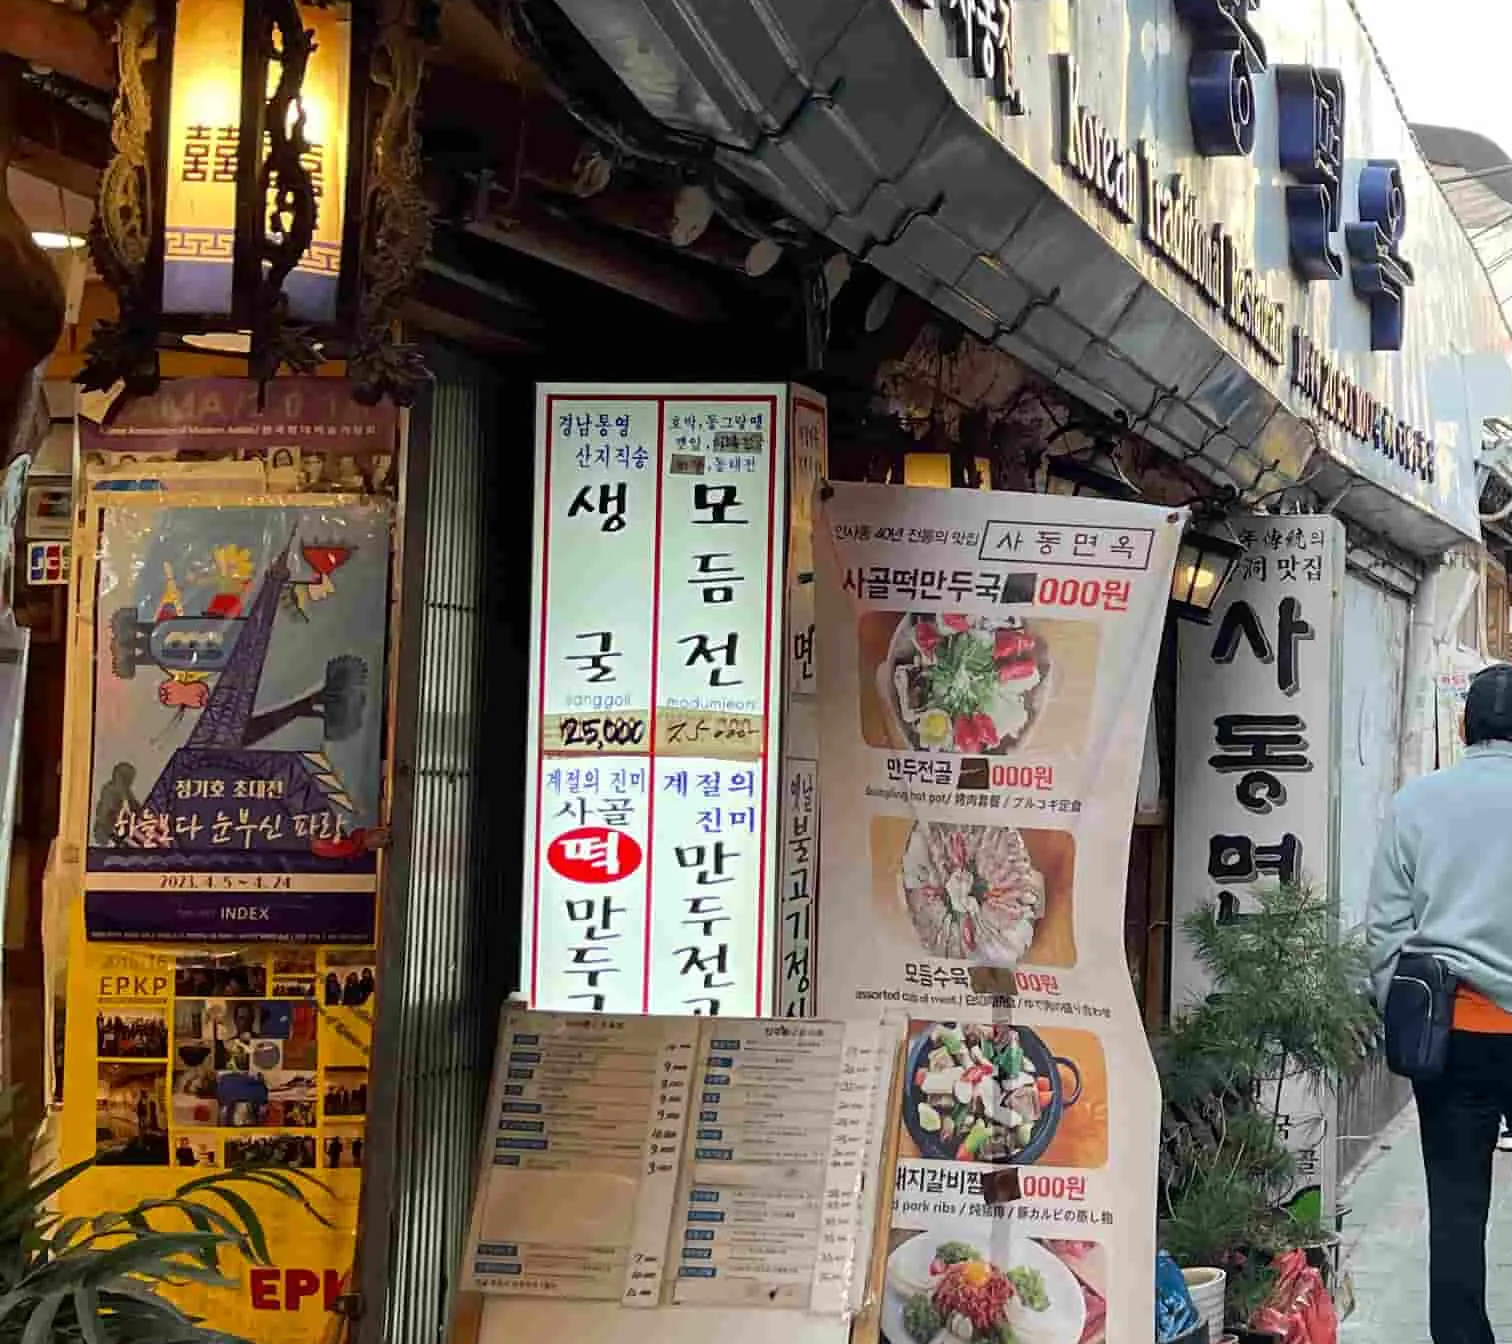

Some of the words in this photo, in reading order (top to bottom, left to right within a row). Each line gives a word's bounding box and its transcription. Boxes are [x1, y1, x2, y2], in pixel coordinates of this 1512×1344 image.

[1066, 54, 1137, 224] Korean
[560, 413, 630, 437] 경남통영
[575, 445, 649, 469] 산지직송
[1277, 554, 1322, 581] 맛집
[842, 567, 1001, 603] 사골떡만두국
[547, 768, 599, 794] 계절의
[611, 768, 646, 793] 진미
[887, 758, 953, 785] 만두전골
[176, 780, 225, 799] 정기호
[232, 779, 284, 799] 초대전
[664, 771, 754, 798] 계절의
[554, 797, 634, 825] 사골
[697, 808, 755, 833] 진미
[212, 807, 283, 848] 눈부신
[292, 812, 346, 841] 파랑
[220, 907, 270, 920] INDEX
[100, 976, 168, 995] EPKP
[905, 963, 968, 988] 모듬수육
[903, 1200, 929, 1214] pork
[933, 1201, 956, 1213] ribs
